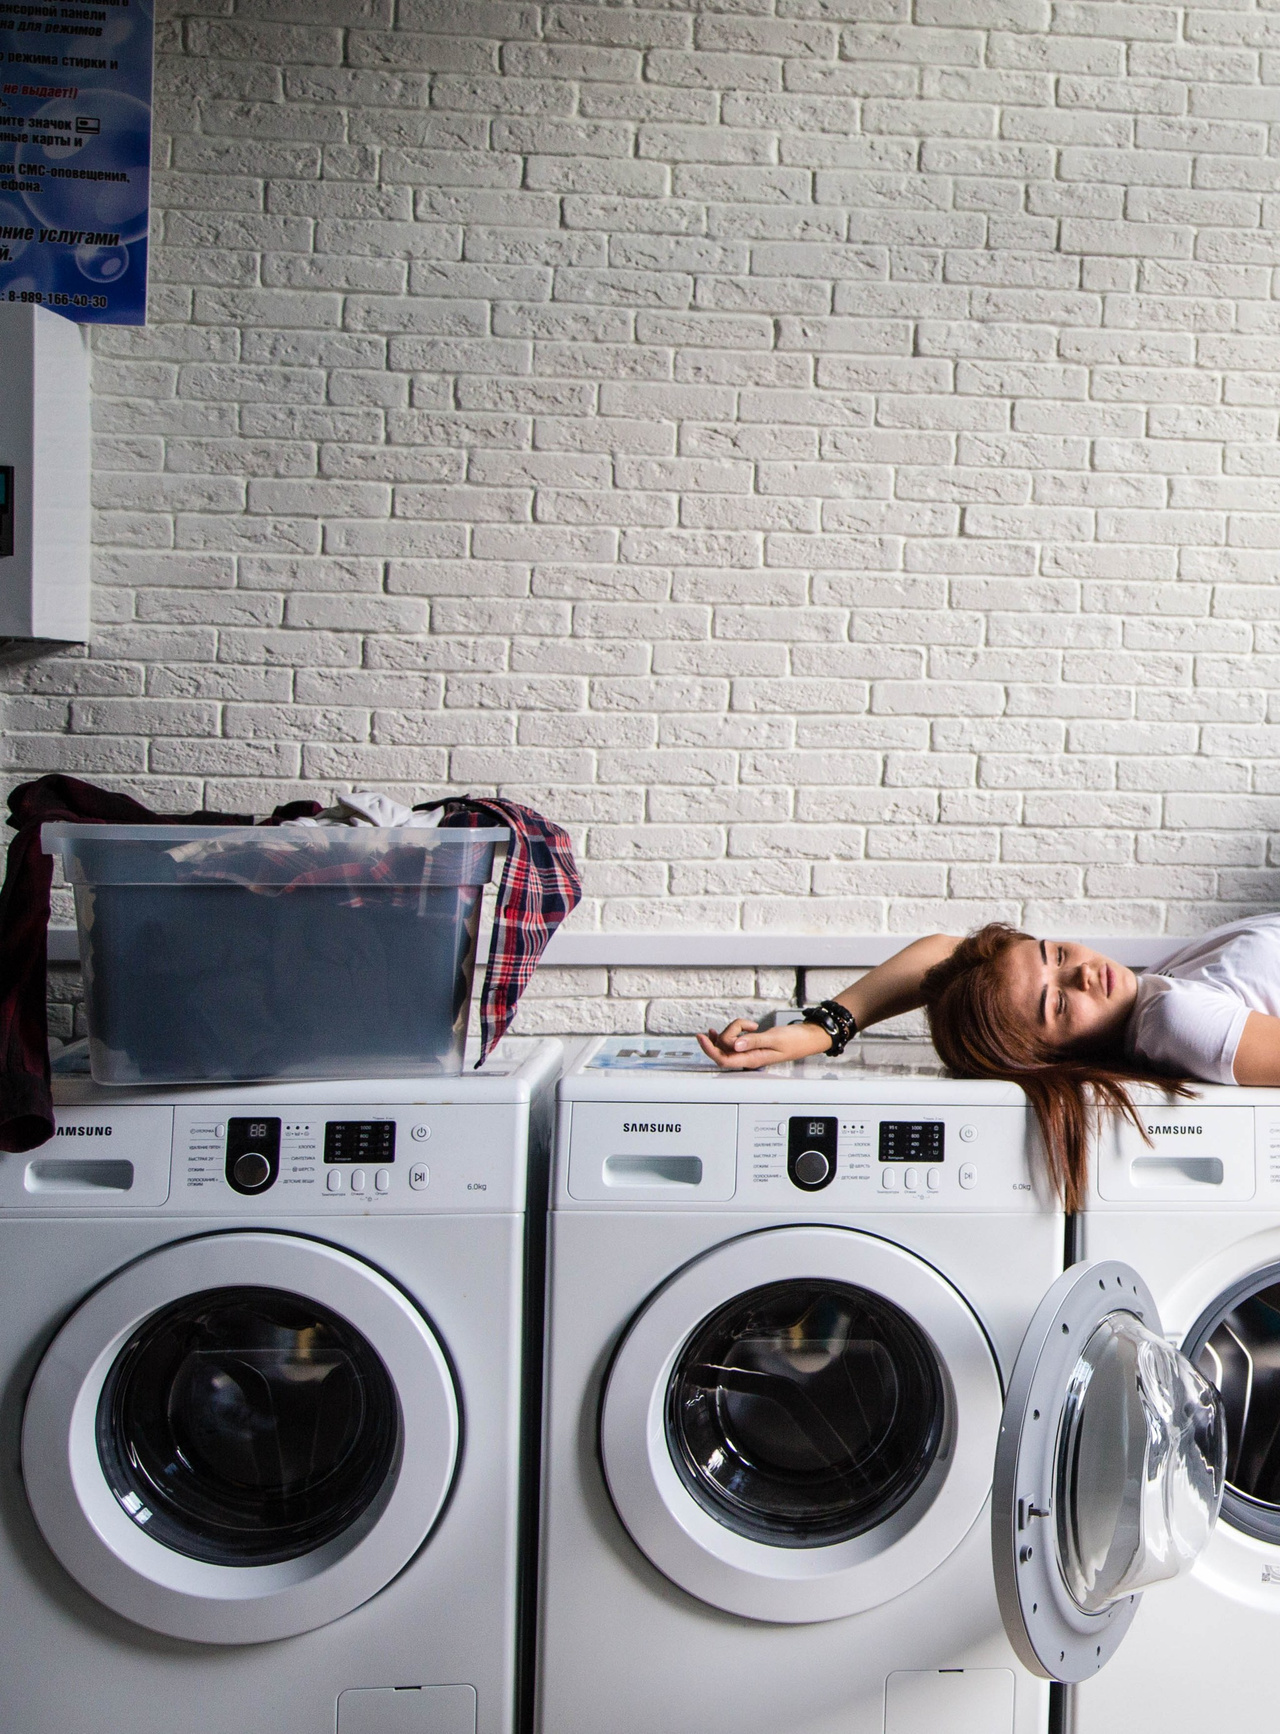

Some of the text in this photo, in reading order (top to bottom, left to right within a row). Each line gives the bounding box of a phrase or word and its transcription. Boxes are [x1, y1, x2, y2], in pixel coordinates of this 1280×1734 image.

[61, 9, 106, 21] панели
[17, 21, 42, 32] для
[45, 23, 103, 37] режимов
[8, 52, 58, 66] режима
[62, 56, 107, 69] стирки
[110, 60, 118, 70] и
[3, 84, 18, 95] не
[28, 119, 72, 131] значок
[32, 135, 70, 147] карты
[74, 137, 82, 147] и
[18, 164, 130, 183] СМС-оповещения,
[38, 229, 120, 247] услугами
[8, 290, 107, 308] 8-989-166-40-30
[56, 1126, 112, 1136] AMSUNG
[623, 1122, 682, 1133] SAMSUNG
[1147, 1125, 1203, 1135] SAMSUNG
[467, 1183, 487, 1191] 6.0kg
